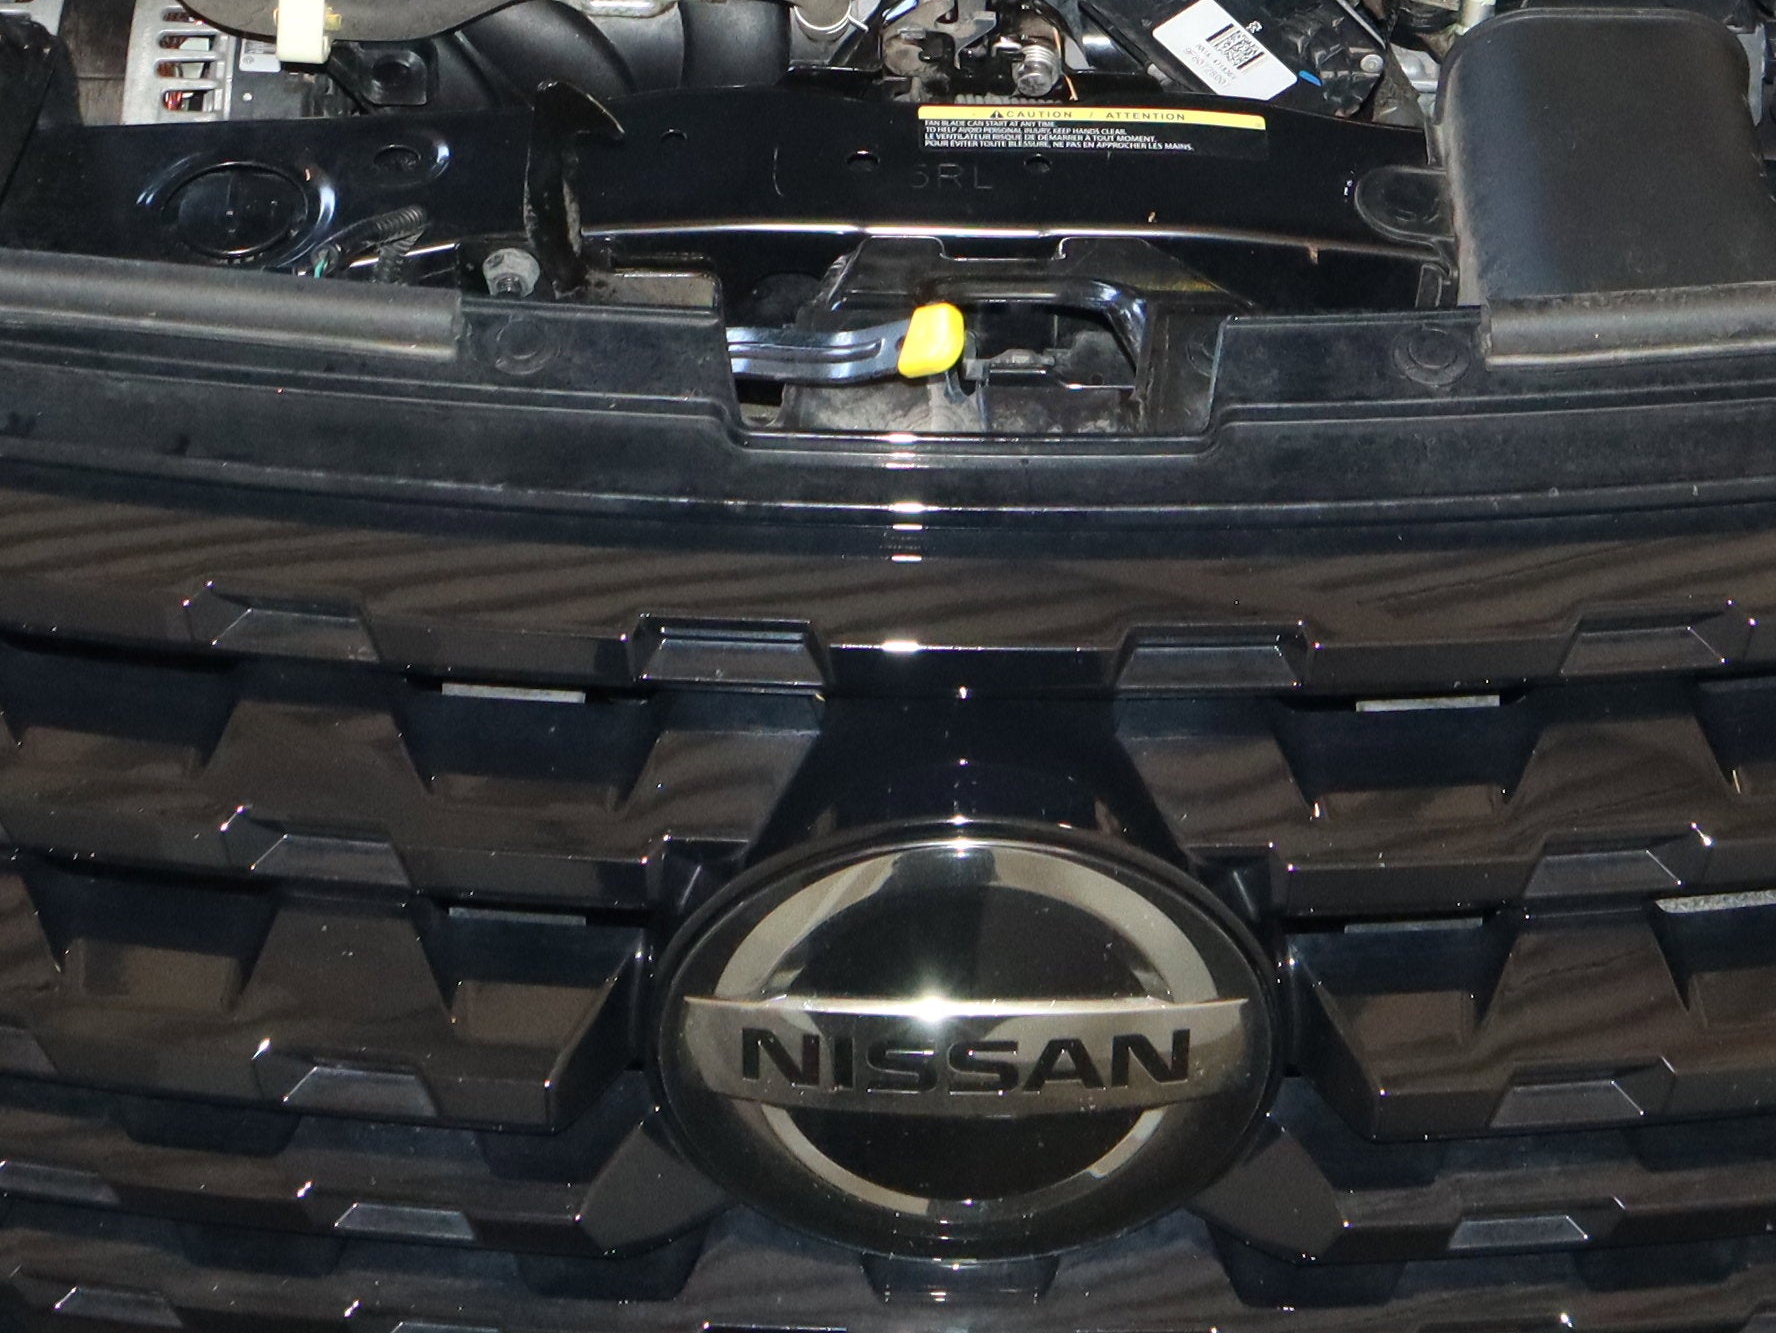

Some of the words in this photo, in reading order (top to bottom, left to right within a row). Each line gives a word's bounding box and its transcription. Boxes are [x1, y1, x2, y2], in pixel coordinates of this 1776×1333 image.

[1006, 110, 1073, 119] CAUTION
[1105, 111, 1186, 121] ATTENTION
[741, 1028, 1191, 1094] NISSAN
